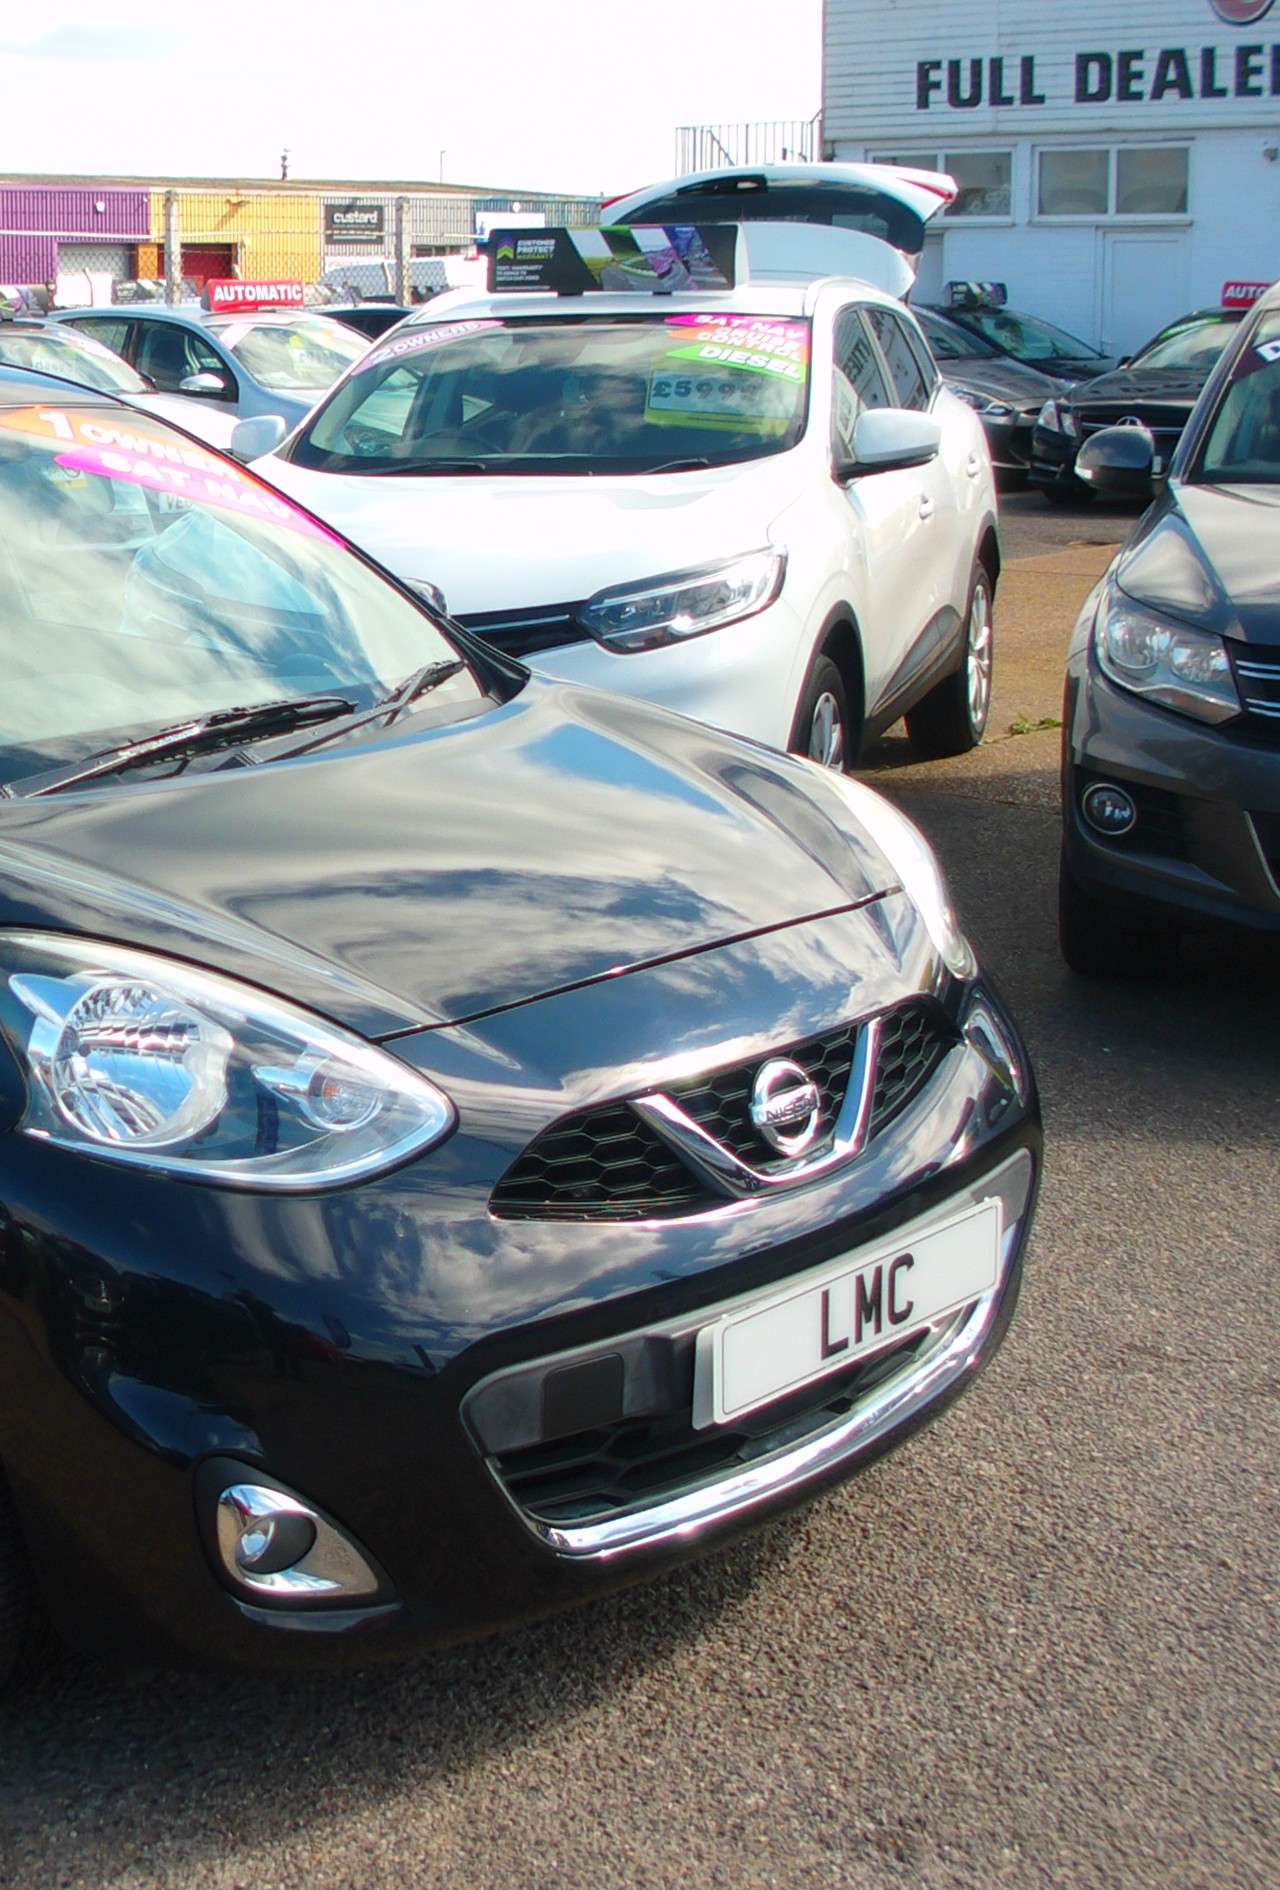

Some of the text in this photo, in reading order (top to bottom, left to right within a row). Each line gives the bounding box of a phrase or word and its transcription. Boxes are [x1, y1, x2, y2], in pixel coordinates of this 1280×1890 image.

[916, 56, 1046, 109] FULL
[333, 210, 377, 224] custard
[214, 284, 302, 301] AUTOMATIC
[394, 322, 480, 353] OWNERS
[694, 315, 804, 338] SAT NAV
[696, 332, 801, 361] CONTROL
[698, 346, 801, 380] DIESEL
[40, 412, 74, 440] 1
[99, 451, 291, 520] SAT NAV
[821, 1253, 914, 1360] LMC
